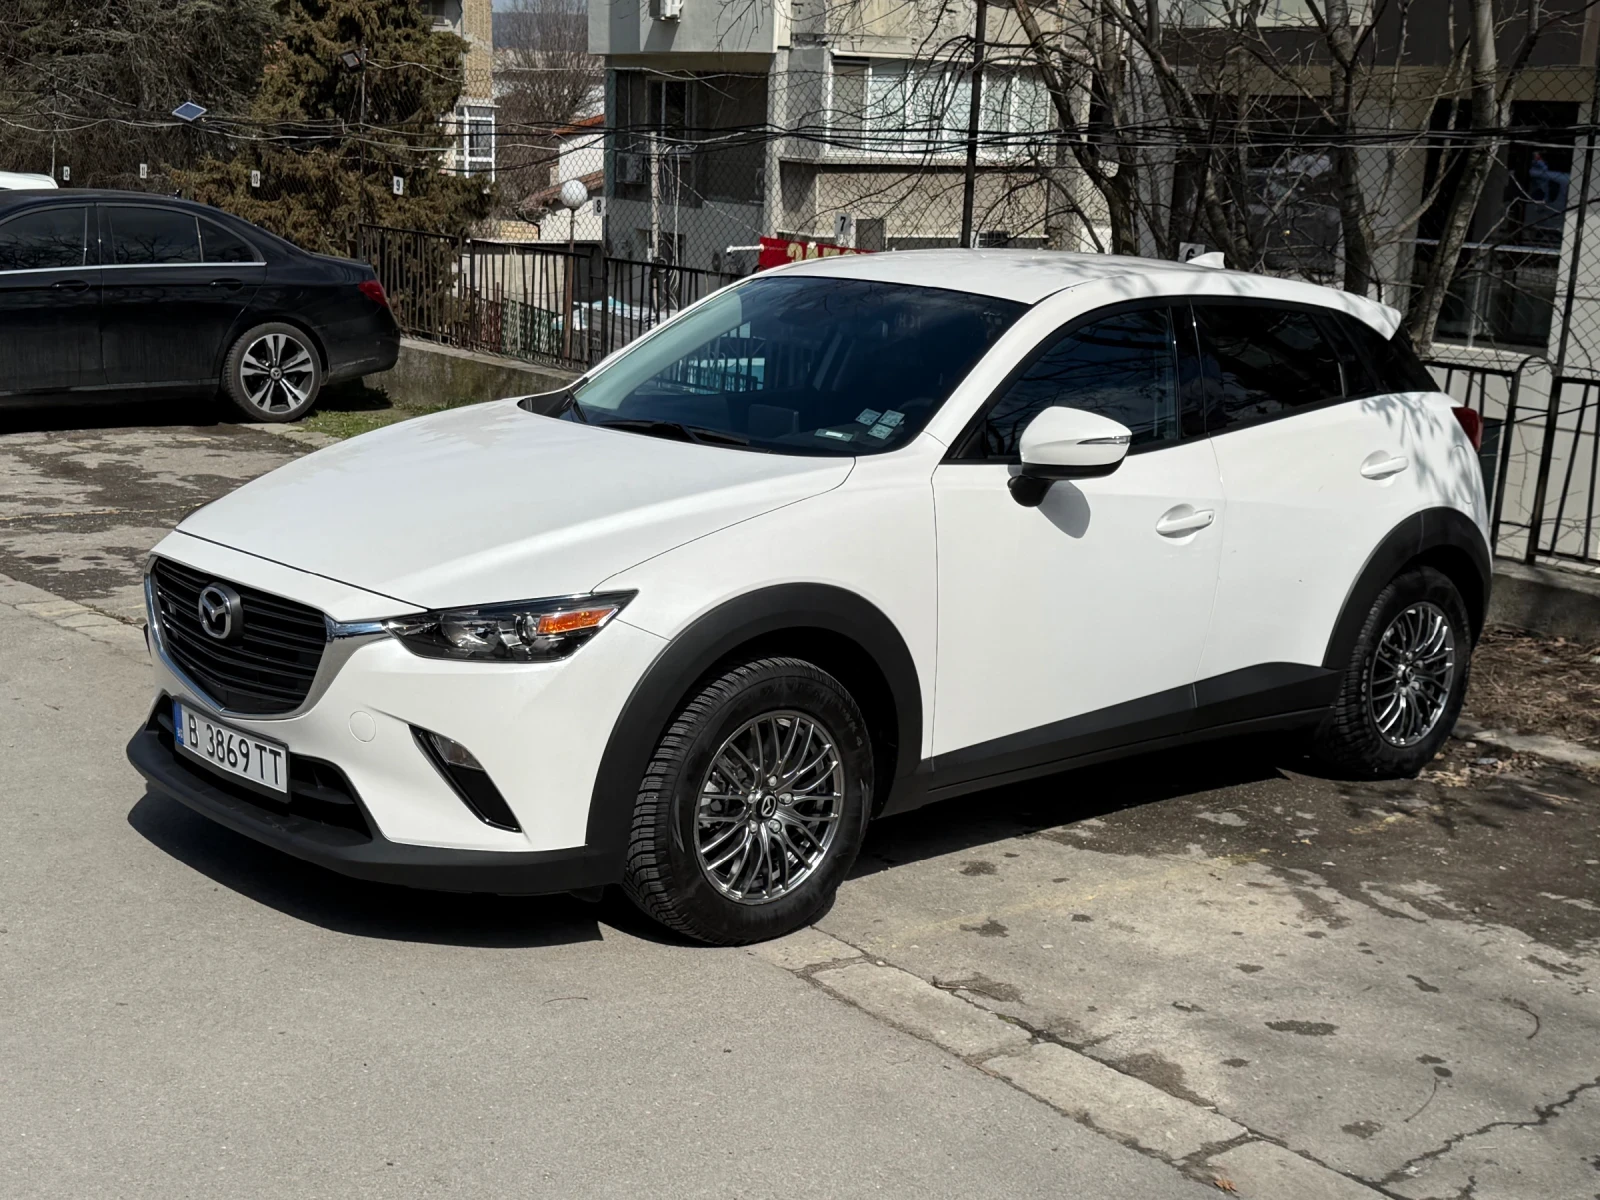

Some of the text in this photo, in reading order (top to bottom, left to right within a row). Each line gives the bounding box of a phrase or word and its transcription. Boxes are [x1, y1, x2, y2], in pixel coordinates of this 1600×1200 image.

[253, 174, 259, 184] 10
[396, 179, 401, 191] 9
[596, 199, 602, 213] 8
[840, 216, 846, 232] 7
[188, 713, 282, 785] B 3869 TT
